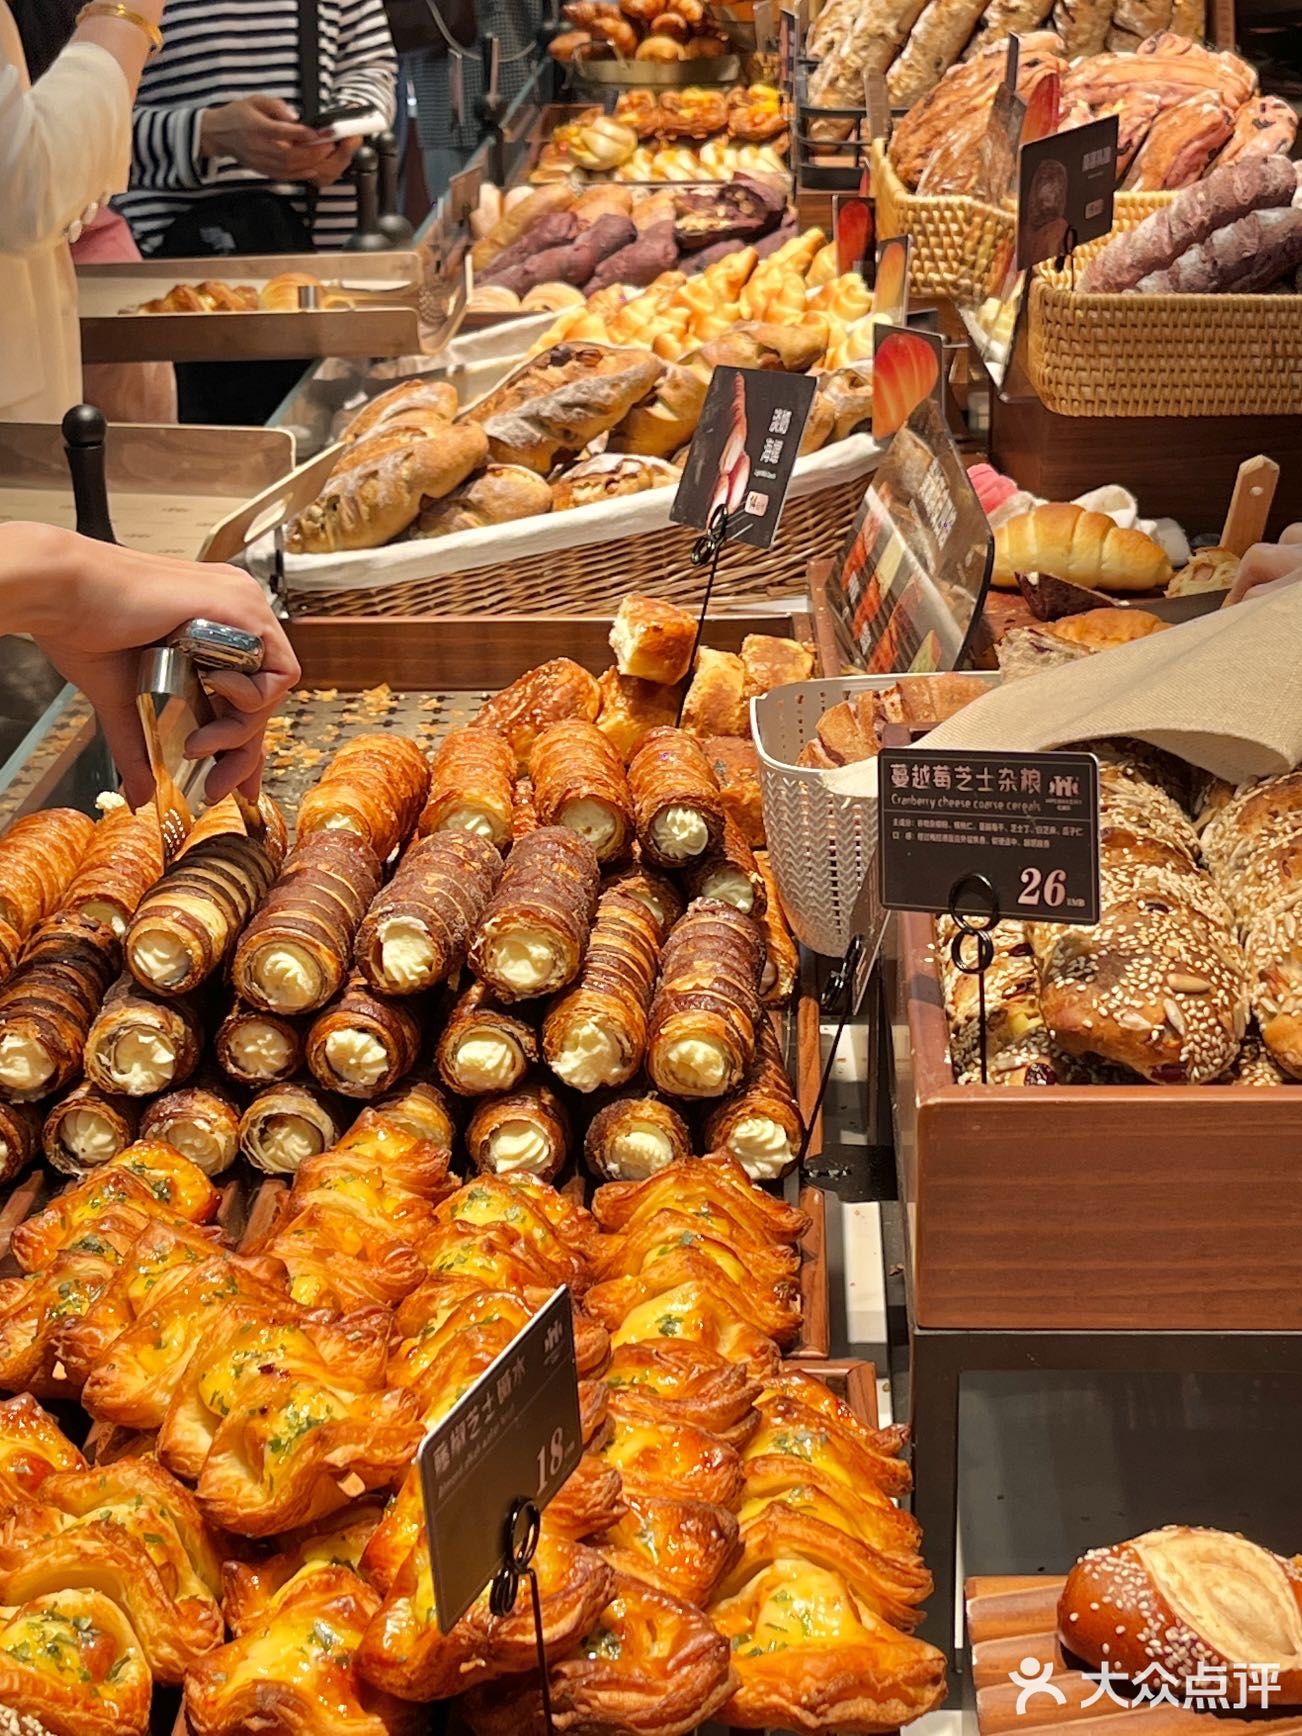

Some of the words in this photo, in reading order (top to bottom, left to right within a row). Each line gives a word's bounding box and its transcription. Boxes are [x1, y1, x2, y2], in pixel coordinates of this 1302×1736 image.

[889, 763, 1042, 795] 蔓越莓芝士杂粮
[891, 793, 936, 809] Cranberry
[938, 796, 971, 810] cheese
[973, 798, 1004, 811] coarse
[1006, 800, 1042, 814] cereals
[1017, 867, 1067, 907] 26
[536, 1426, 565, 1497] 18
